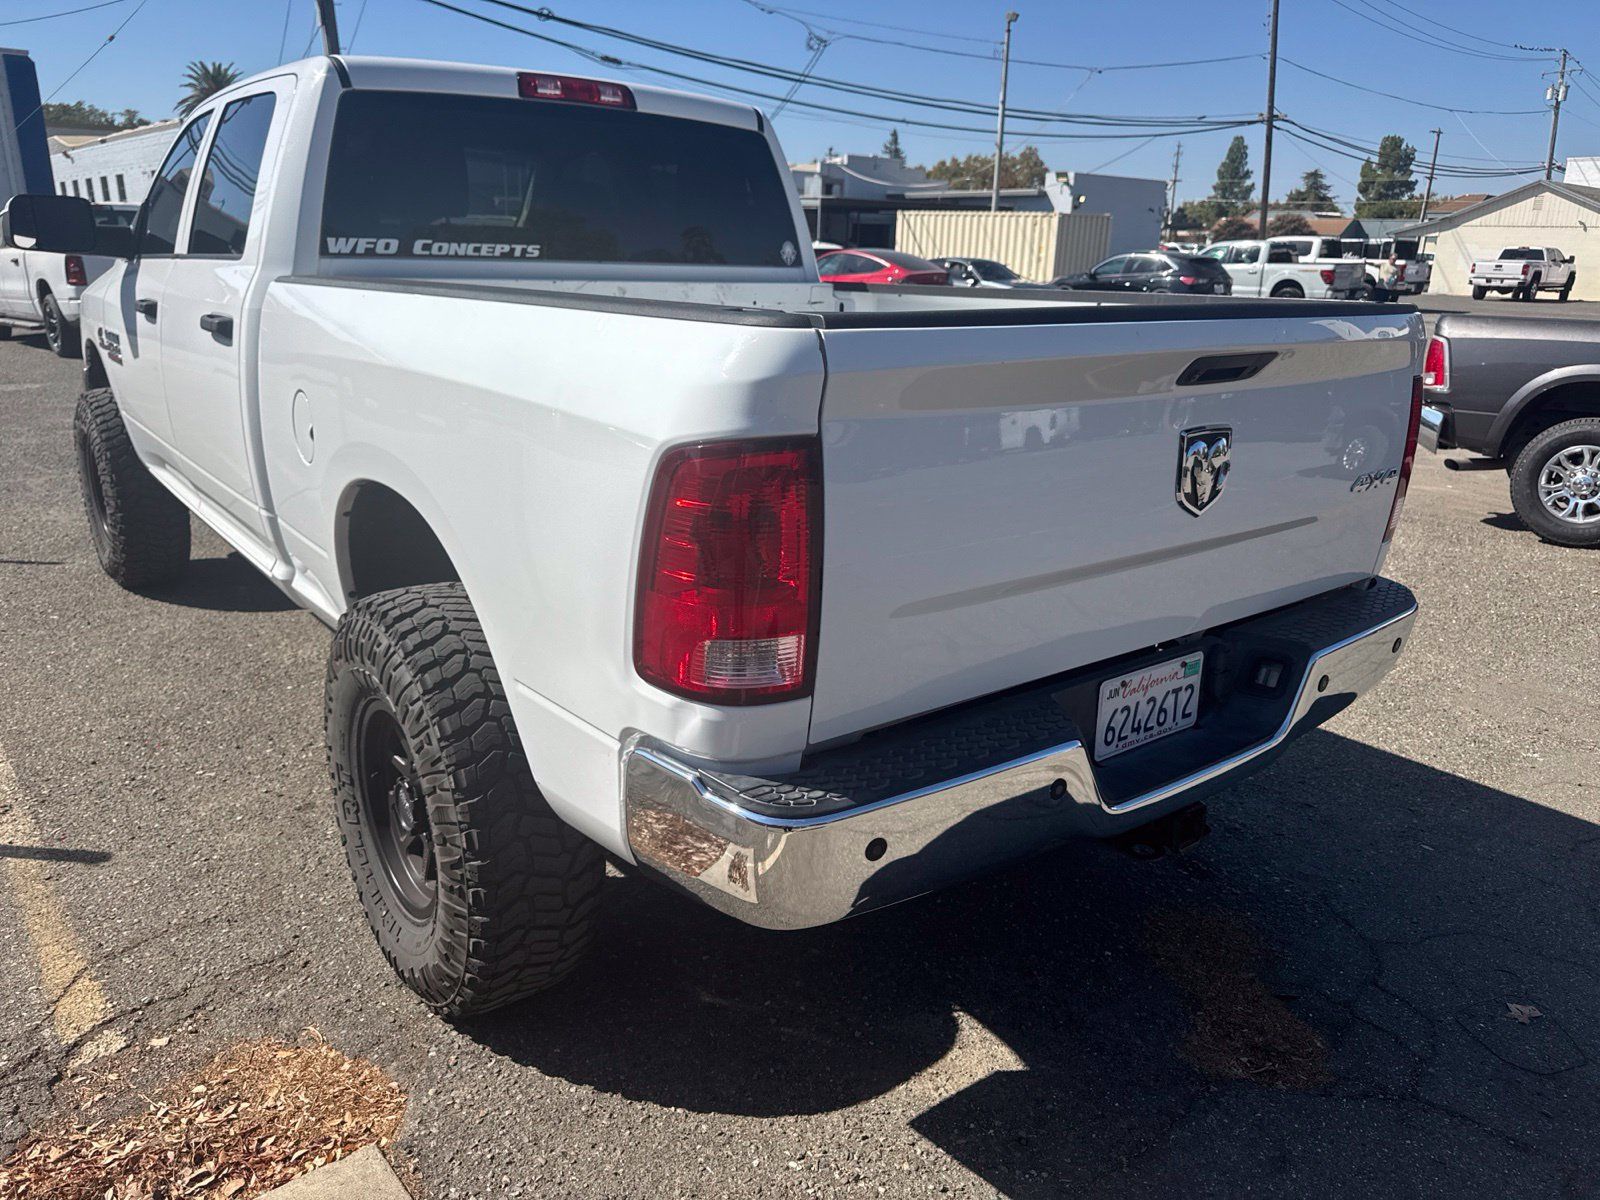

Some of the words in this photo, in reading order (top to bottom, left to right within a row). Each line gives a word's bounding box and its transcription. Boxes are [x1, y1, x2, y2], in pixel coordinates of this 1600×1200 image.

[326, 237, 400, 255] WFO
[1121, 671, 1185, 699] California
[1103, 683, 1196, 747] 62426T2
